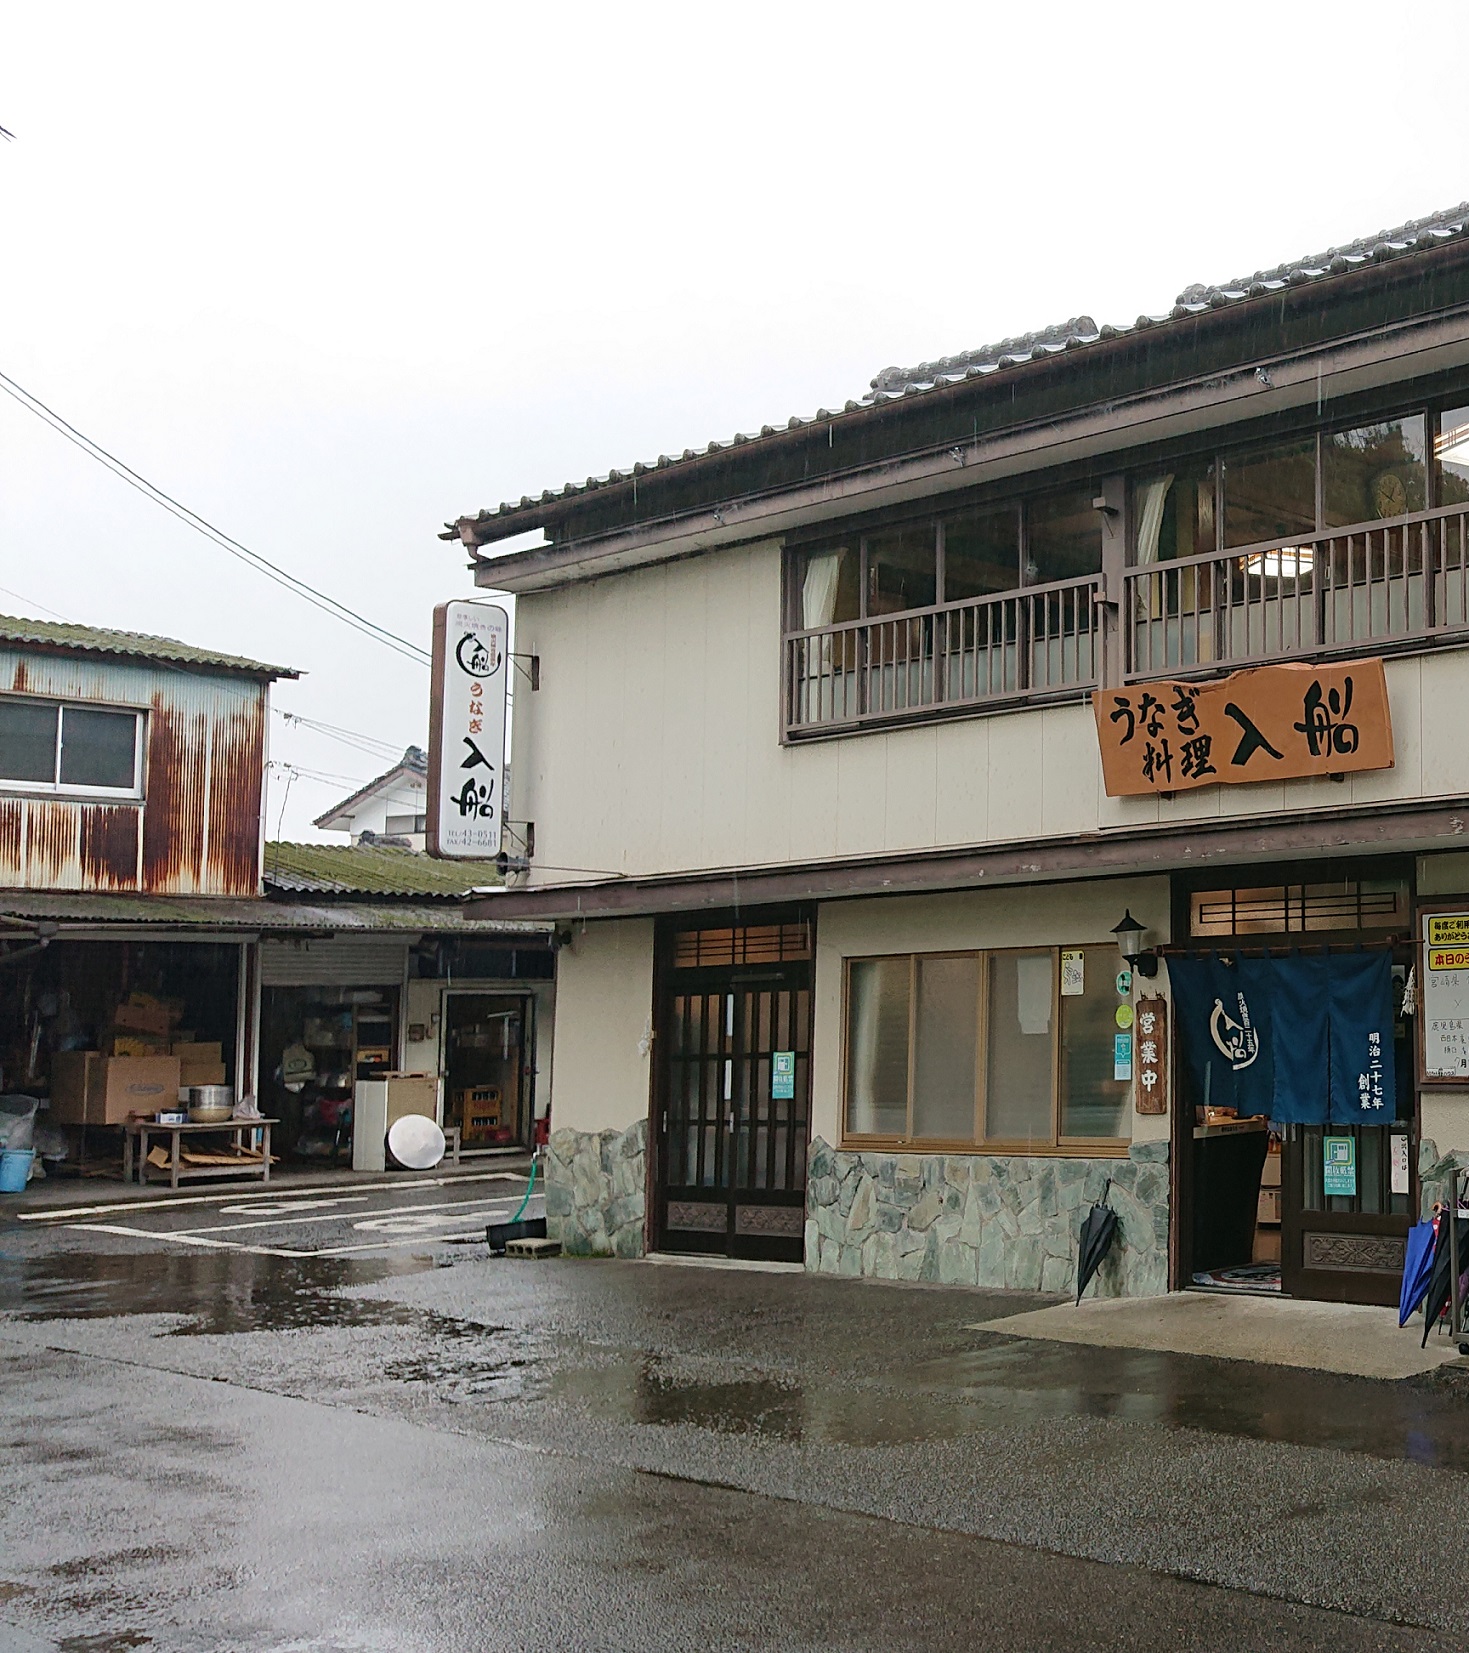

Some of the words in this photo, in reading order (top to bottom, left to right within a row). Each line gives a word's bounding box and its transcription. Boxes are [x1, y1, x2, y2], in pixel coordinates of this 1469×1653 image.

[469, 682, 483, 734] うなぎ
[1109, 685, 1200, 746] うなぎ
[1224, 676, 1359, 766] 入船
[450, 736, 495, 822] 入船
[1142, 734, 1217, 784] 料理
[1139, 1012, 1158, 1092] 営業中
[1368, 1032, 1384, 1110] 明治二十七年
[1358, 1073, 1371, 1110] 創業
